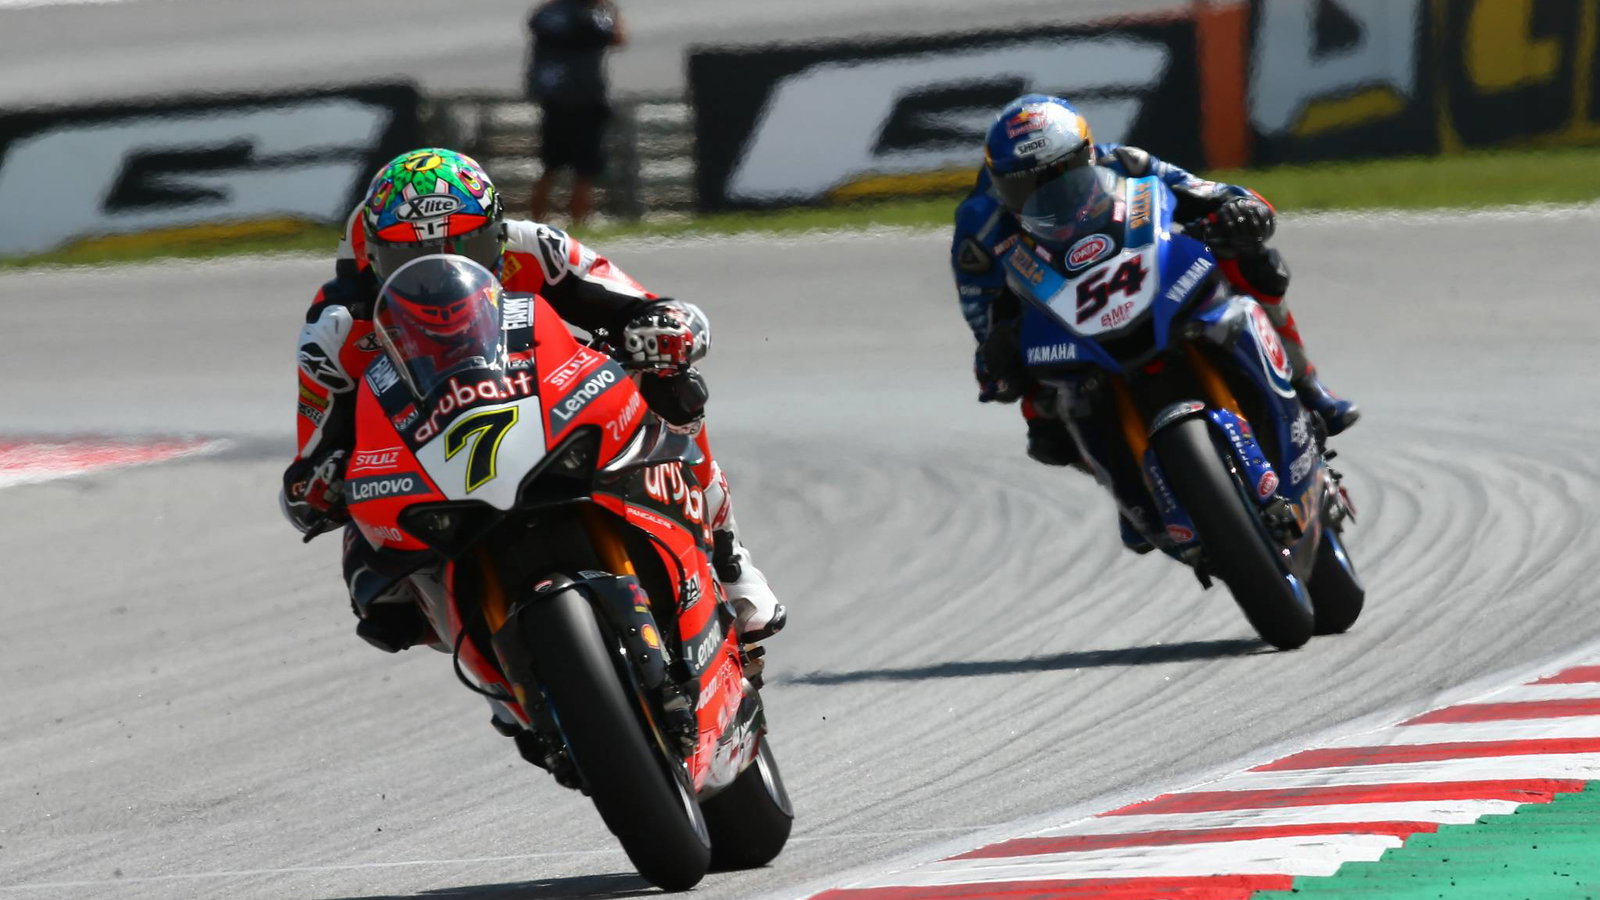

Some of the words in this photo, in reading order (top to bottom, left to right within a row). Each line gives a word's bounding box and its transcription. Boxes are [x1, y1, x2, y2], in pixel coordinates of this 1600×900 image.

[405, 199, 454, 220] X-lite
[1075, 253, 1149, 324] 54
[1165, 256, 1213, 303] YAMAHA
[1101, 301, 1134, 327] BMP
[1027, 342, 1077, 364] YAMAHA
[414, 369, 533, 443] aruba.it
[552, 369, 616, 421] Lenovo
[444, 404, 519, 494] 7
[351, 477, 414, 500] Lenovo
